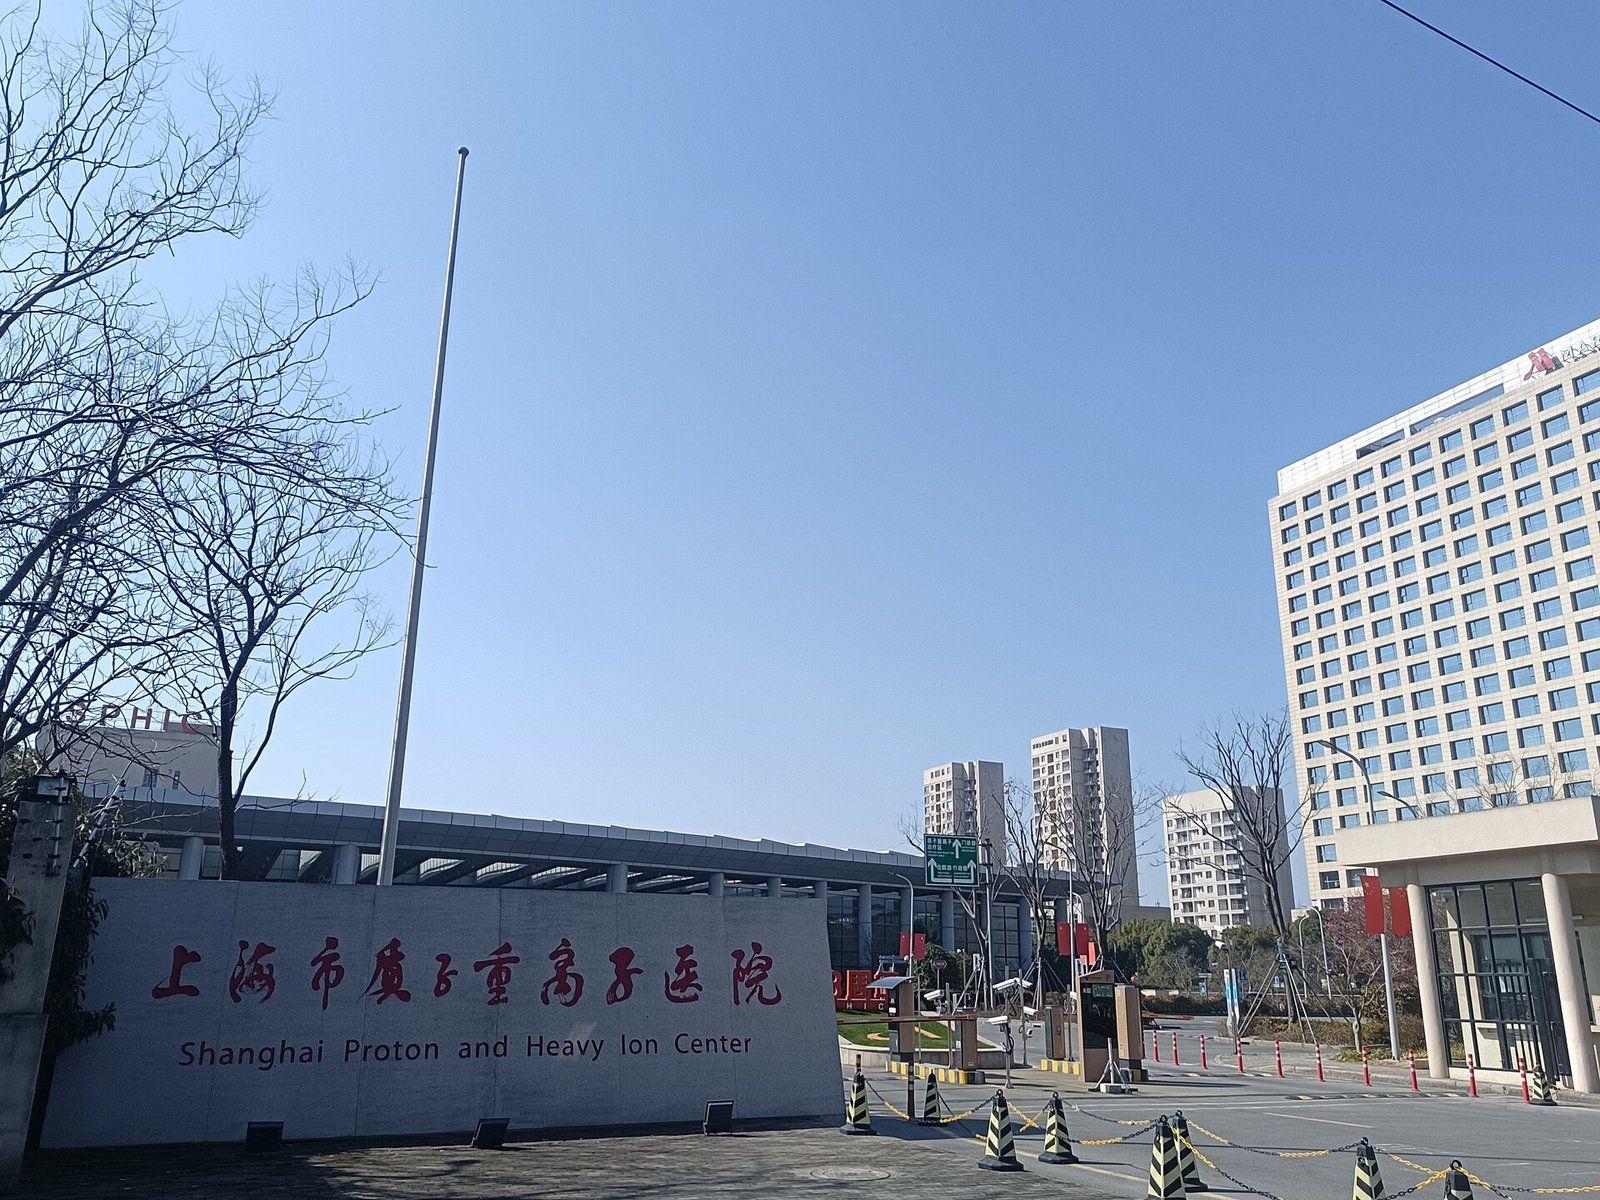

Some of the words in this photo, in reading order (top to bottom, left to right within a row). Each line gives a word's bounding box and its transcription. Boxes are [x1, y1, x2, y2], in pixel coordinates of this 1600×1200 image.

[67, 702, 203, 734] SPHIC
[152, 937, 782, 1010] 上海市质子重离子医院
[178, 1039, 324, 1071] Shanghai
[344, 1039, 439, 1062] Proton
[458, 1035, 508, 1058] and
[527, 1034, 604, 1061] Heavy
[621, 1034, 658, 1055] Ion
[674, 1033, 752, 1054] Center
